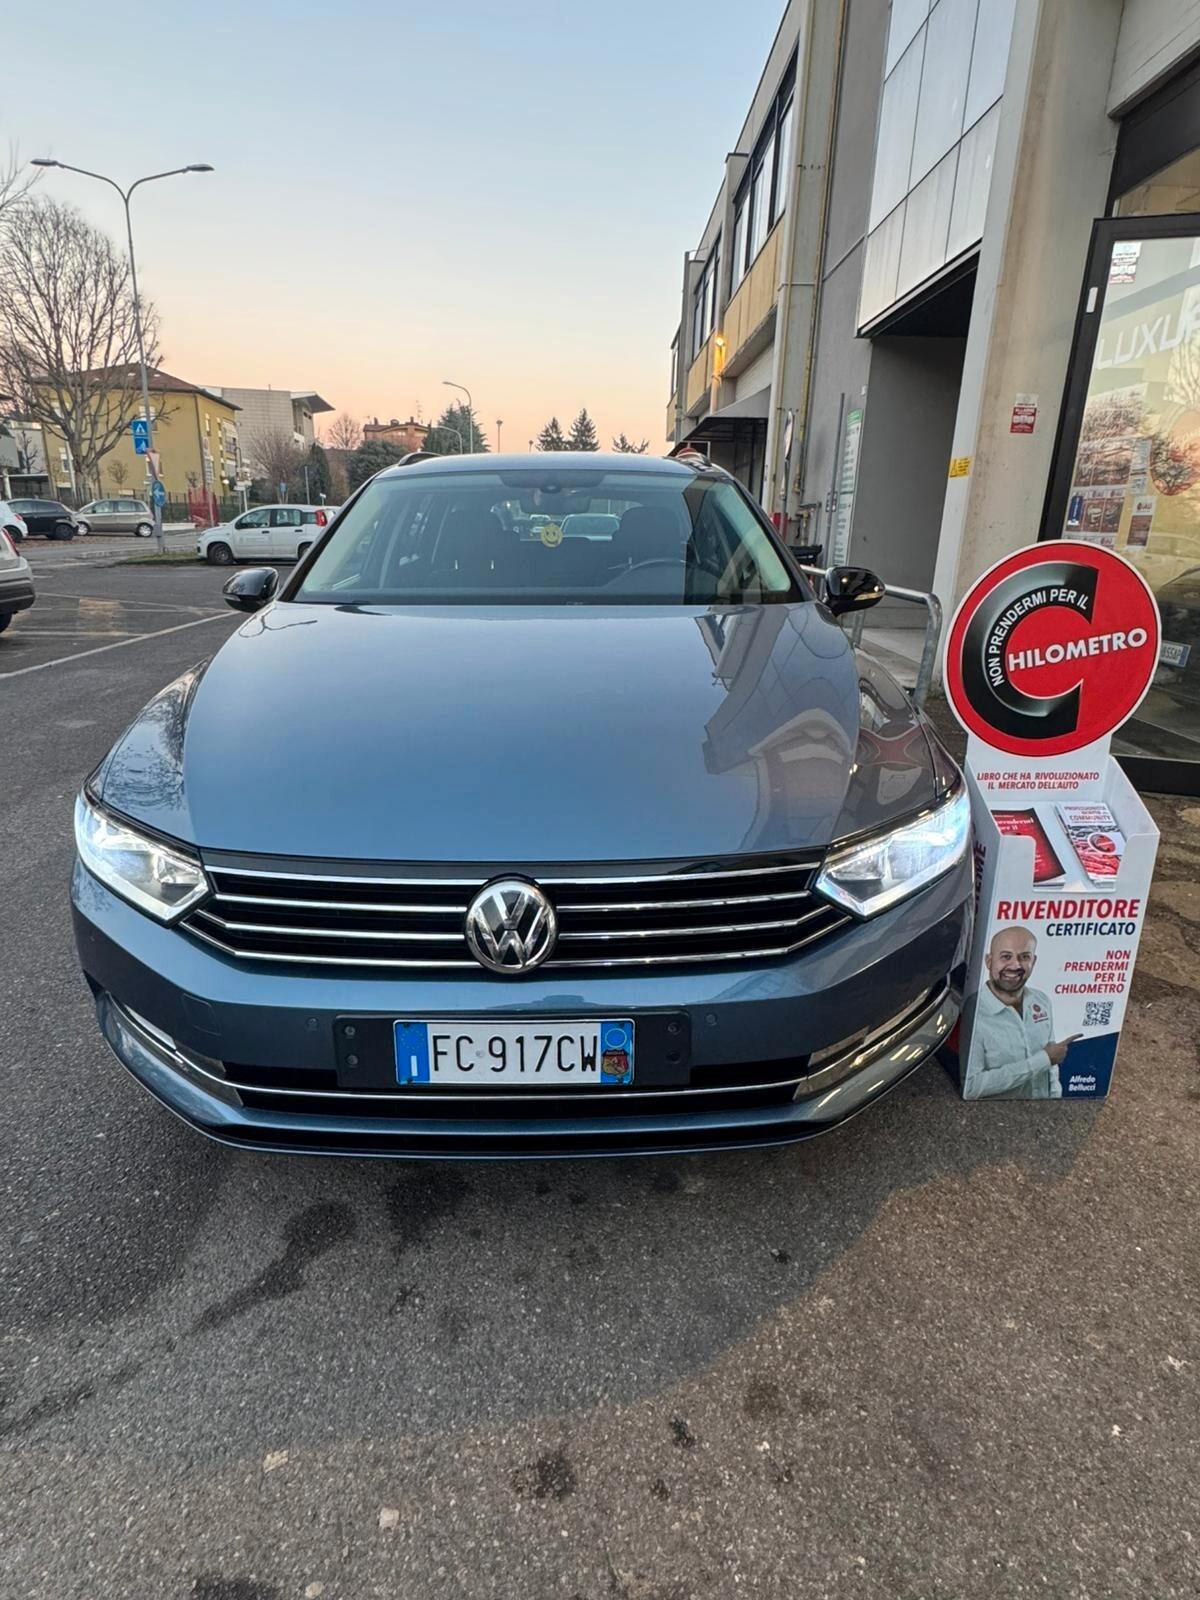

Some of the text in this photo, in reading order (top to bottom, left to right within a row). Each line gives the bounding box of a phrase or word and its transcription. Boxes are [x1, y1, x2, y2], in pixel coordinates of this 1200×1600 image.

[988, 588, 1089, 687] NON PRENDERMI PER IL
[977, 771, 1100, 781] LIBRO CHE HA RIVOLUZIONATO
[987, 781, 1079, 790] IL MERCATO DELL'AUTO
[997, 899, 1140, 920] RIVENDITORE
[1046, 922, 1136, 936] CERTIFICATO
[1106, 950, 1131, 960] NON
[1064, 961, 1129, 971] PRENDERMI
[1095, 973, 1127, 982] PER IL
[1055, 984, 1125, 994] CHILOMETRO
[1069, 1075, 1096, 1083] Alfredo
[1068, 1083, 1096, 1091] Bellucci
